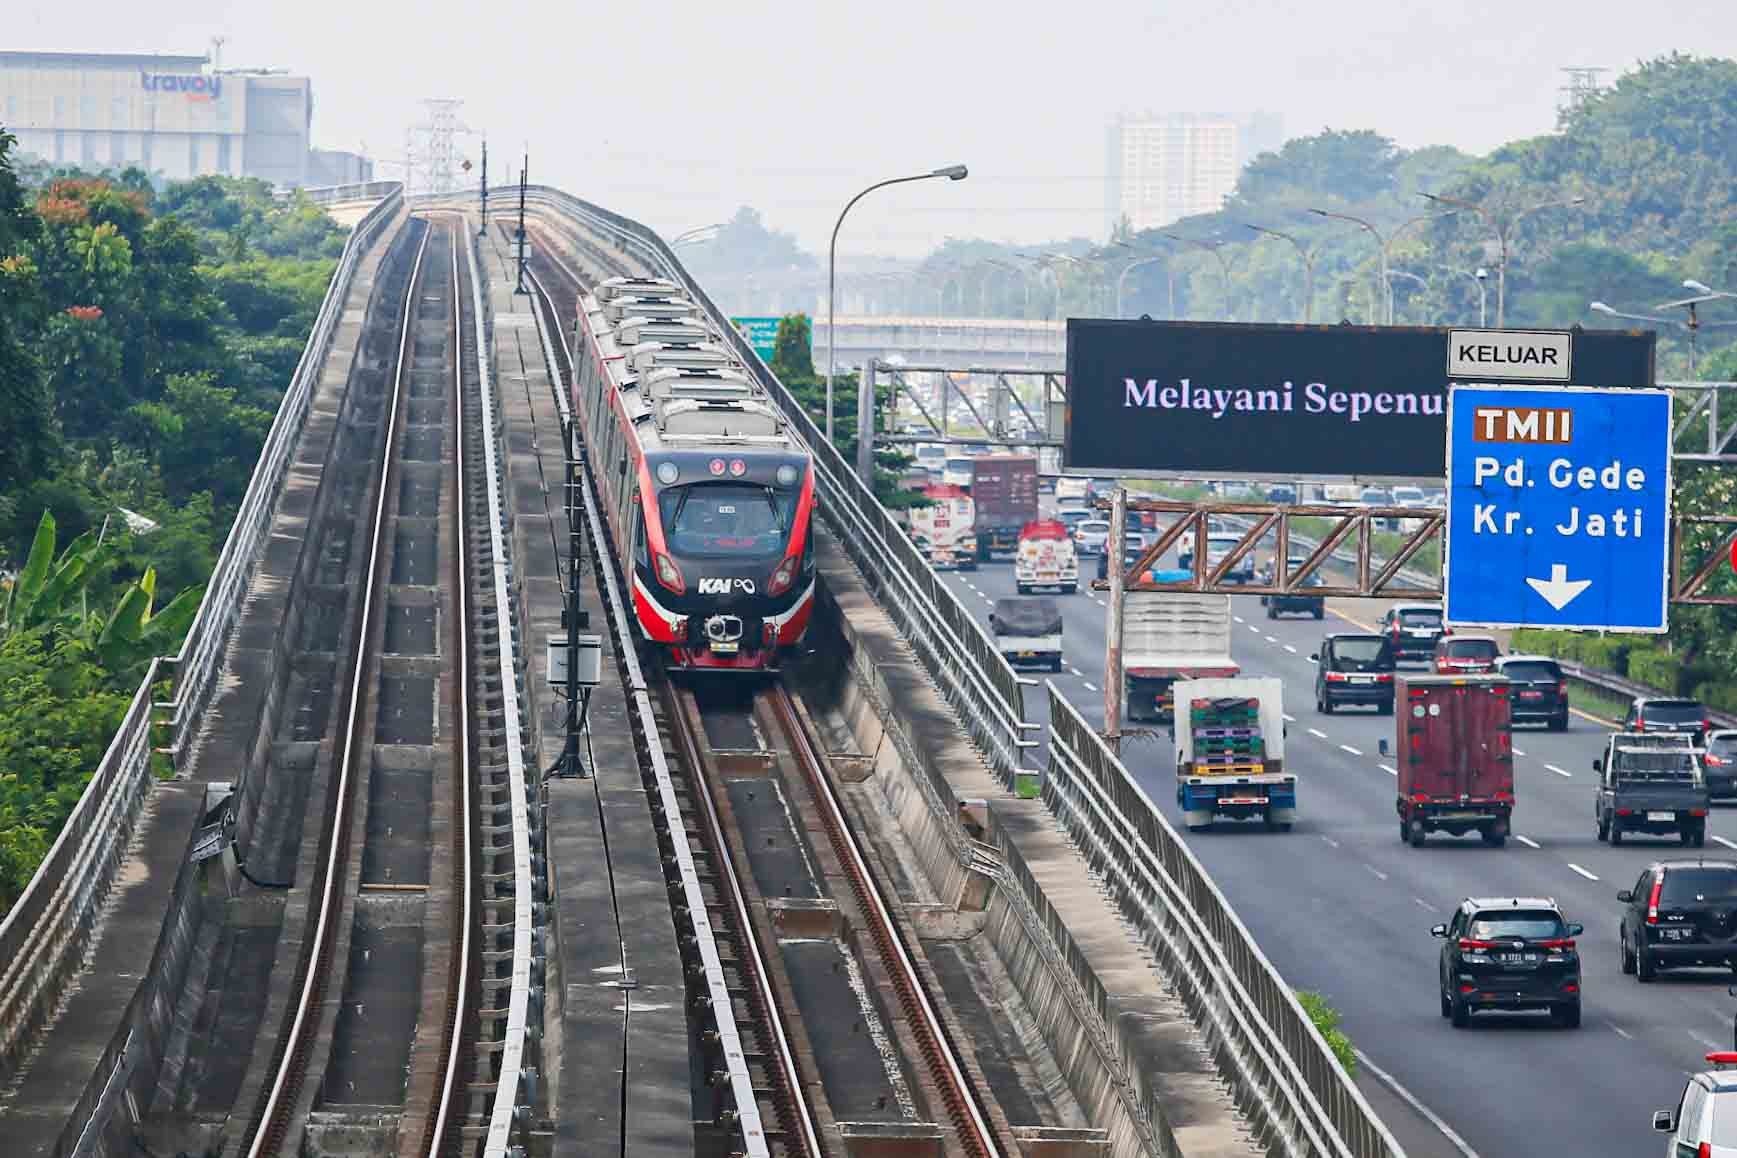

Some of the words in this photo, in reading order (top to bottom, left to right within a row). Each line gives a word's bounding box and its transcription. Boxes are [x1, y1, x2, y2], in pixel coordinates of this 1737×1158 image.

[139, 66, 222, 98] travoy
[1458, 344, 1558, 365] KELUAR
[1123, 378, 1293, 418] Melayani
[1477, 409, 1571, 442] TMII
[1473, 457, 1535, 488] Pd.
[1548, 458, 1646, 490] Gede
[1473, 504, 1534, 534] Kr.
[1555, 507, 1643, 537] Jati
[698, 577, 732, 594] KAI
